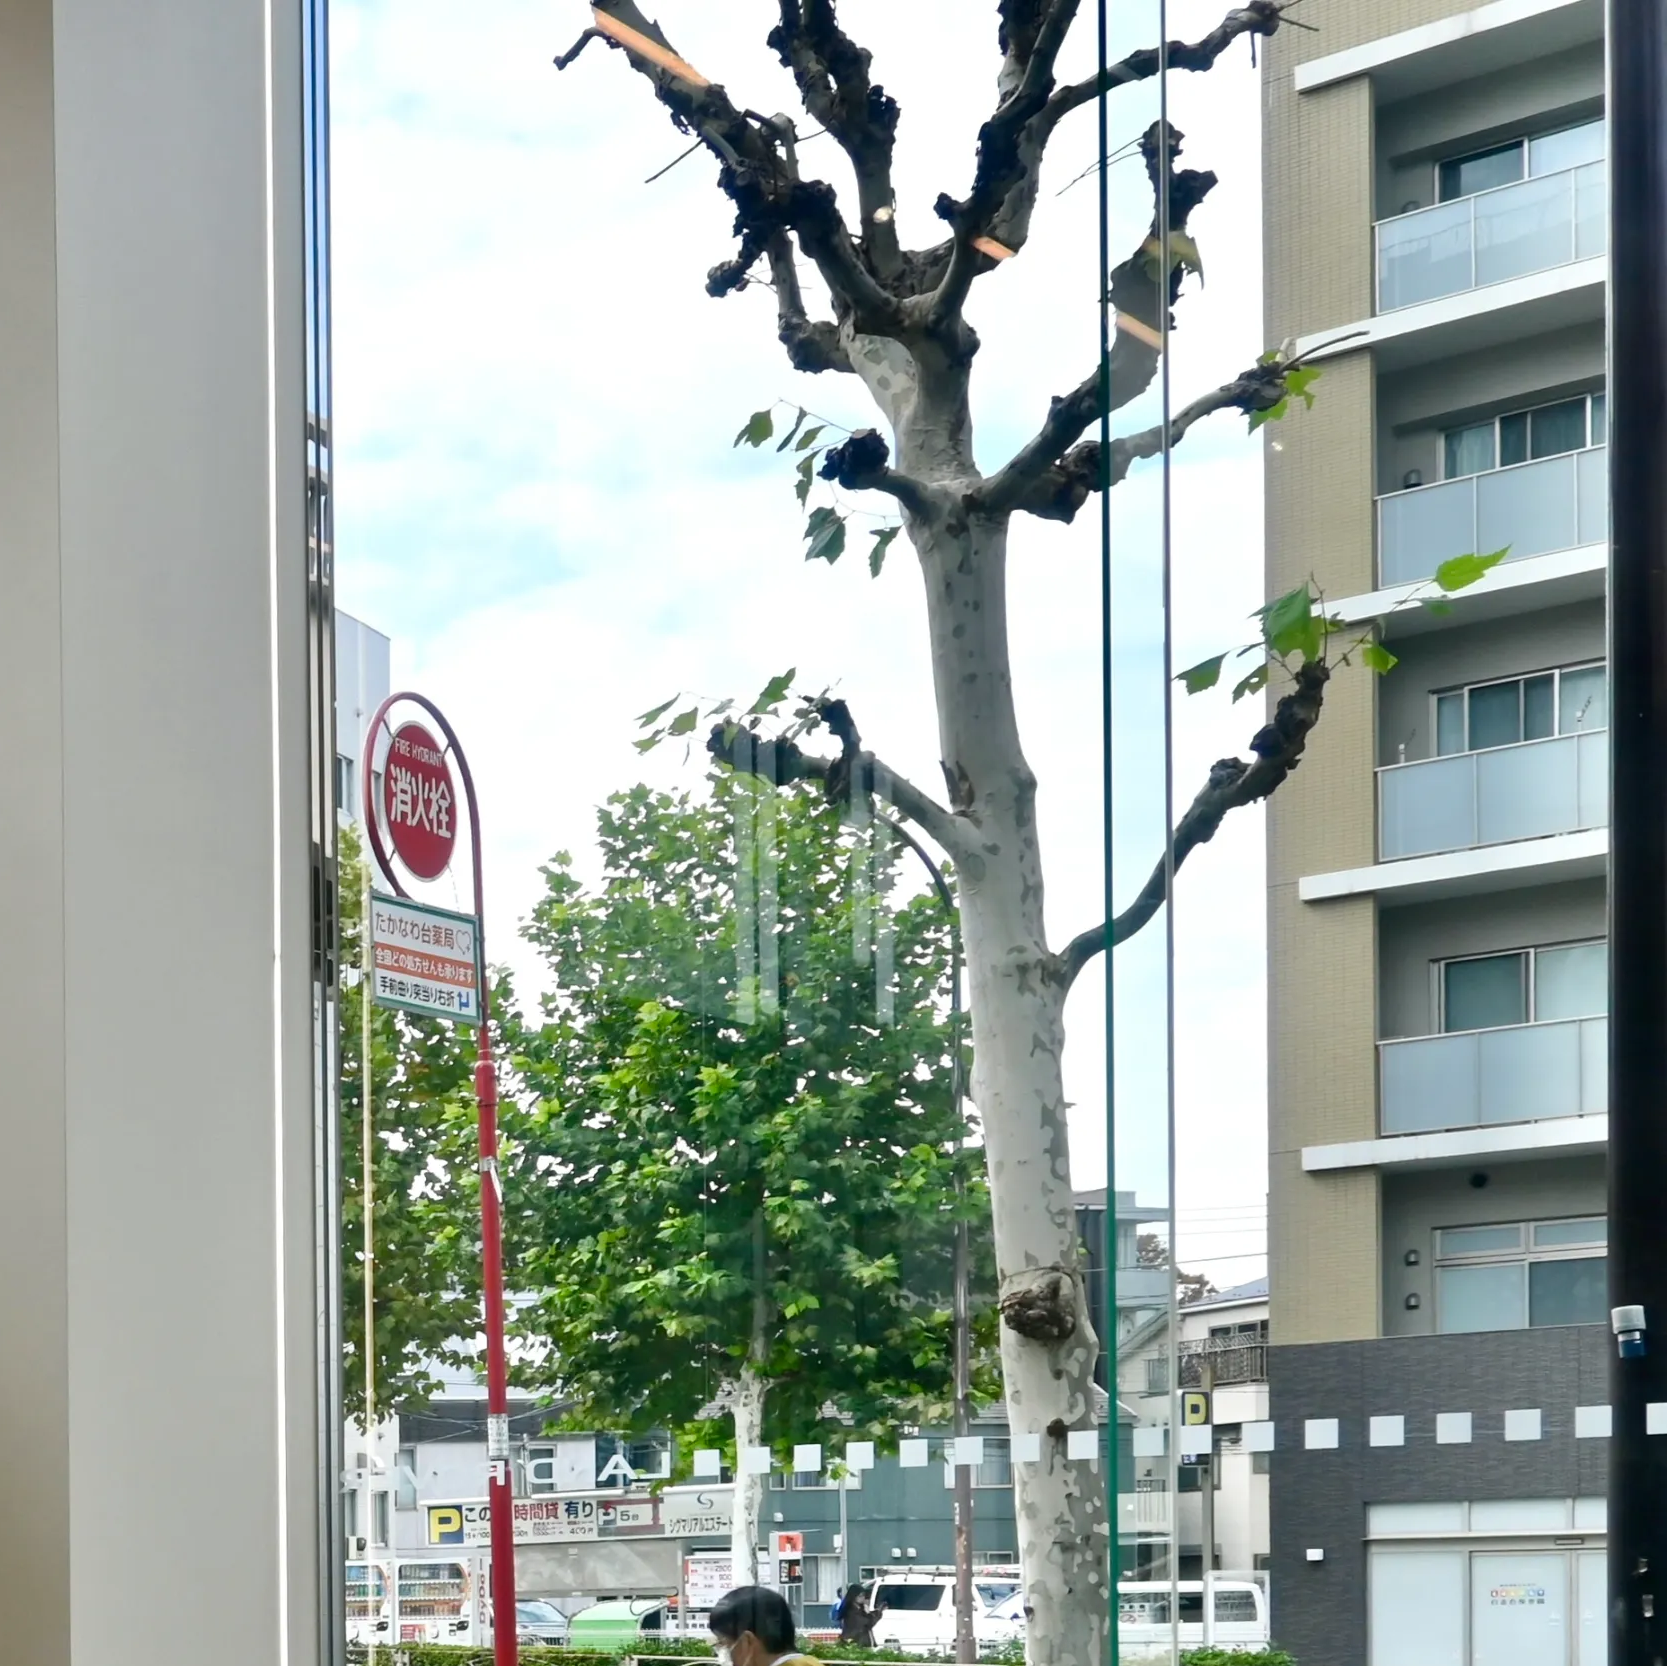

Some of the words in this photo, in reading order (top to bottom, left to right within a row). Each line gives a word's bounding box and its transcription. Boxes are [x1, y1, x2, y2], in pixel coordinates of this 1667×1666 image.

[395, 738, 410, 757] FIRE
[412, 743, 444, 768] HYDRANT
[390, 763, 452, 838] 消火栓
[375, 911, 455, 950] たかなわ台薬局
[429, 1508, 462, 1544] P
